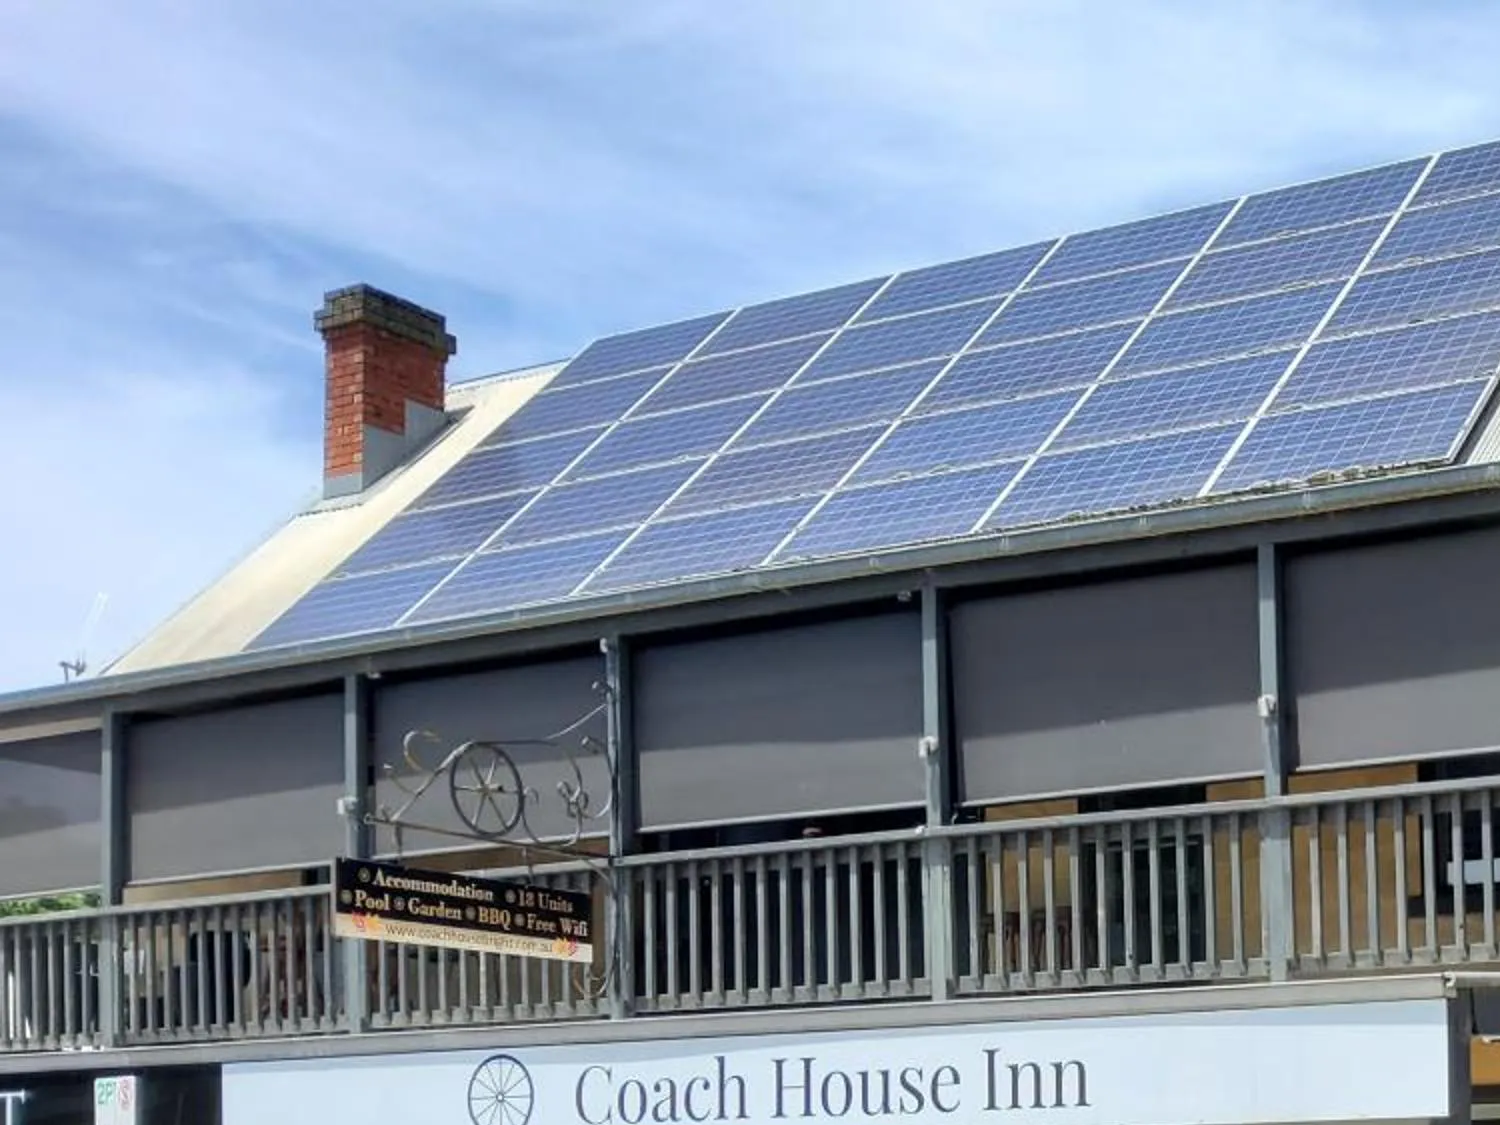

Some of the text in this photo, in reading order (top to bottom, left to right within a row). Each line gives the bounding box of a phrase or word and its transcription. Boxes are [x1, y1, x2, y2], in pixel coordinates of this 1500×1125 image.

[354, 889, 390, 911] Pool
[407, 897, 462, 920] Garden
[479, 906, 512, 931] BBQ
[526, 912, 556, 933] Free
[372, 867, 494, 900] Accommodation
[538, 892, 573, 913] Units
[575, 1048, 1092, 1125] Coach House Inn
